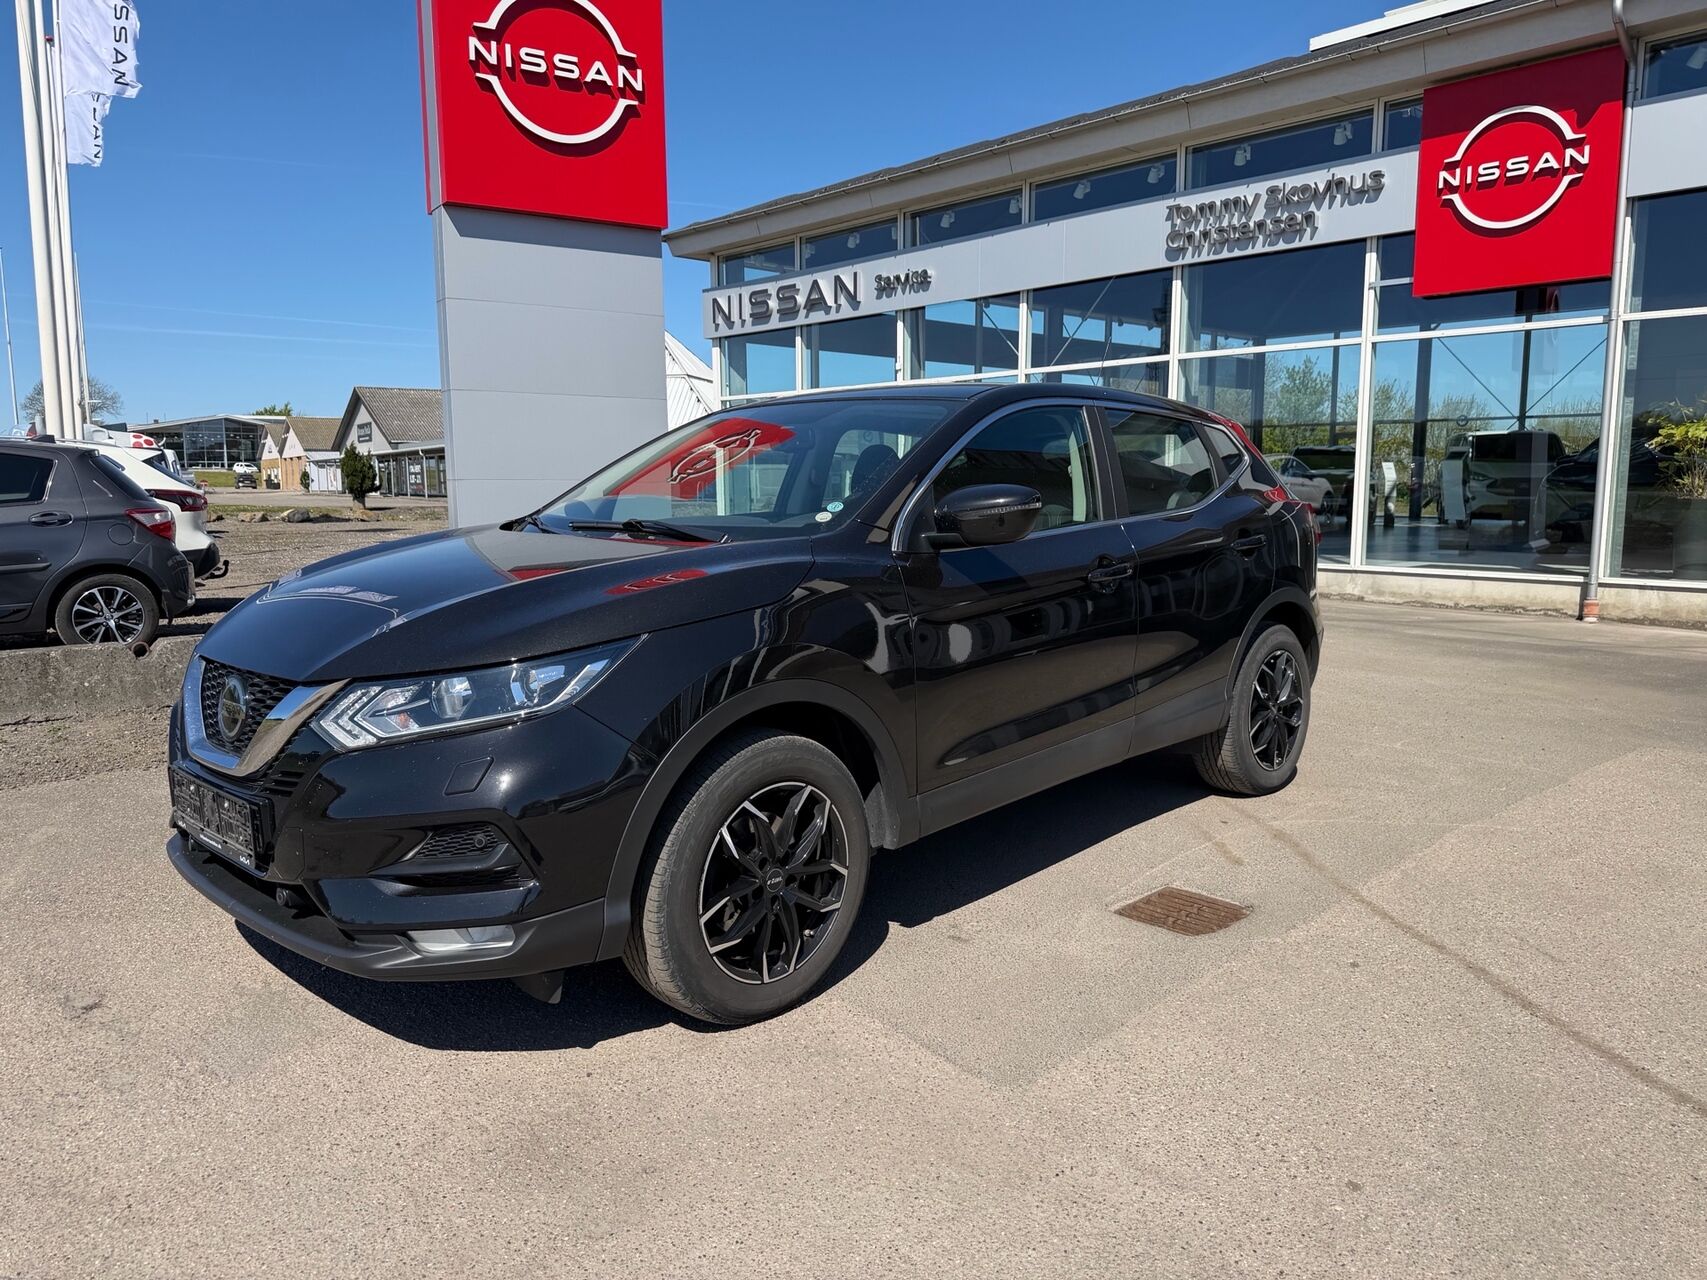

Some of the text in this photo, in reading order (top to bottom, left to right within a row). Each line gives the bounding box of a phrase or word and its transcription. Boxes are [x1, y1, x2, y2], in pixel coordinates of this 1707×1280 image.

[468, 36, 643, 91] NISSAN
[1438, 145, 1590, 189] NISSAN
[1166, 170, 1385, 224] Tommy Skovhus
[1165, 210, 1317, 250] Christensen
[712, 268, 931, 325] NISSAN Service
